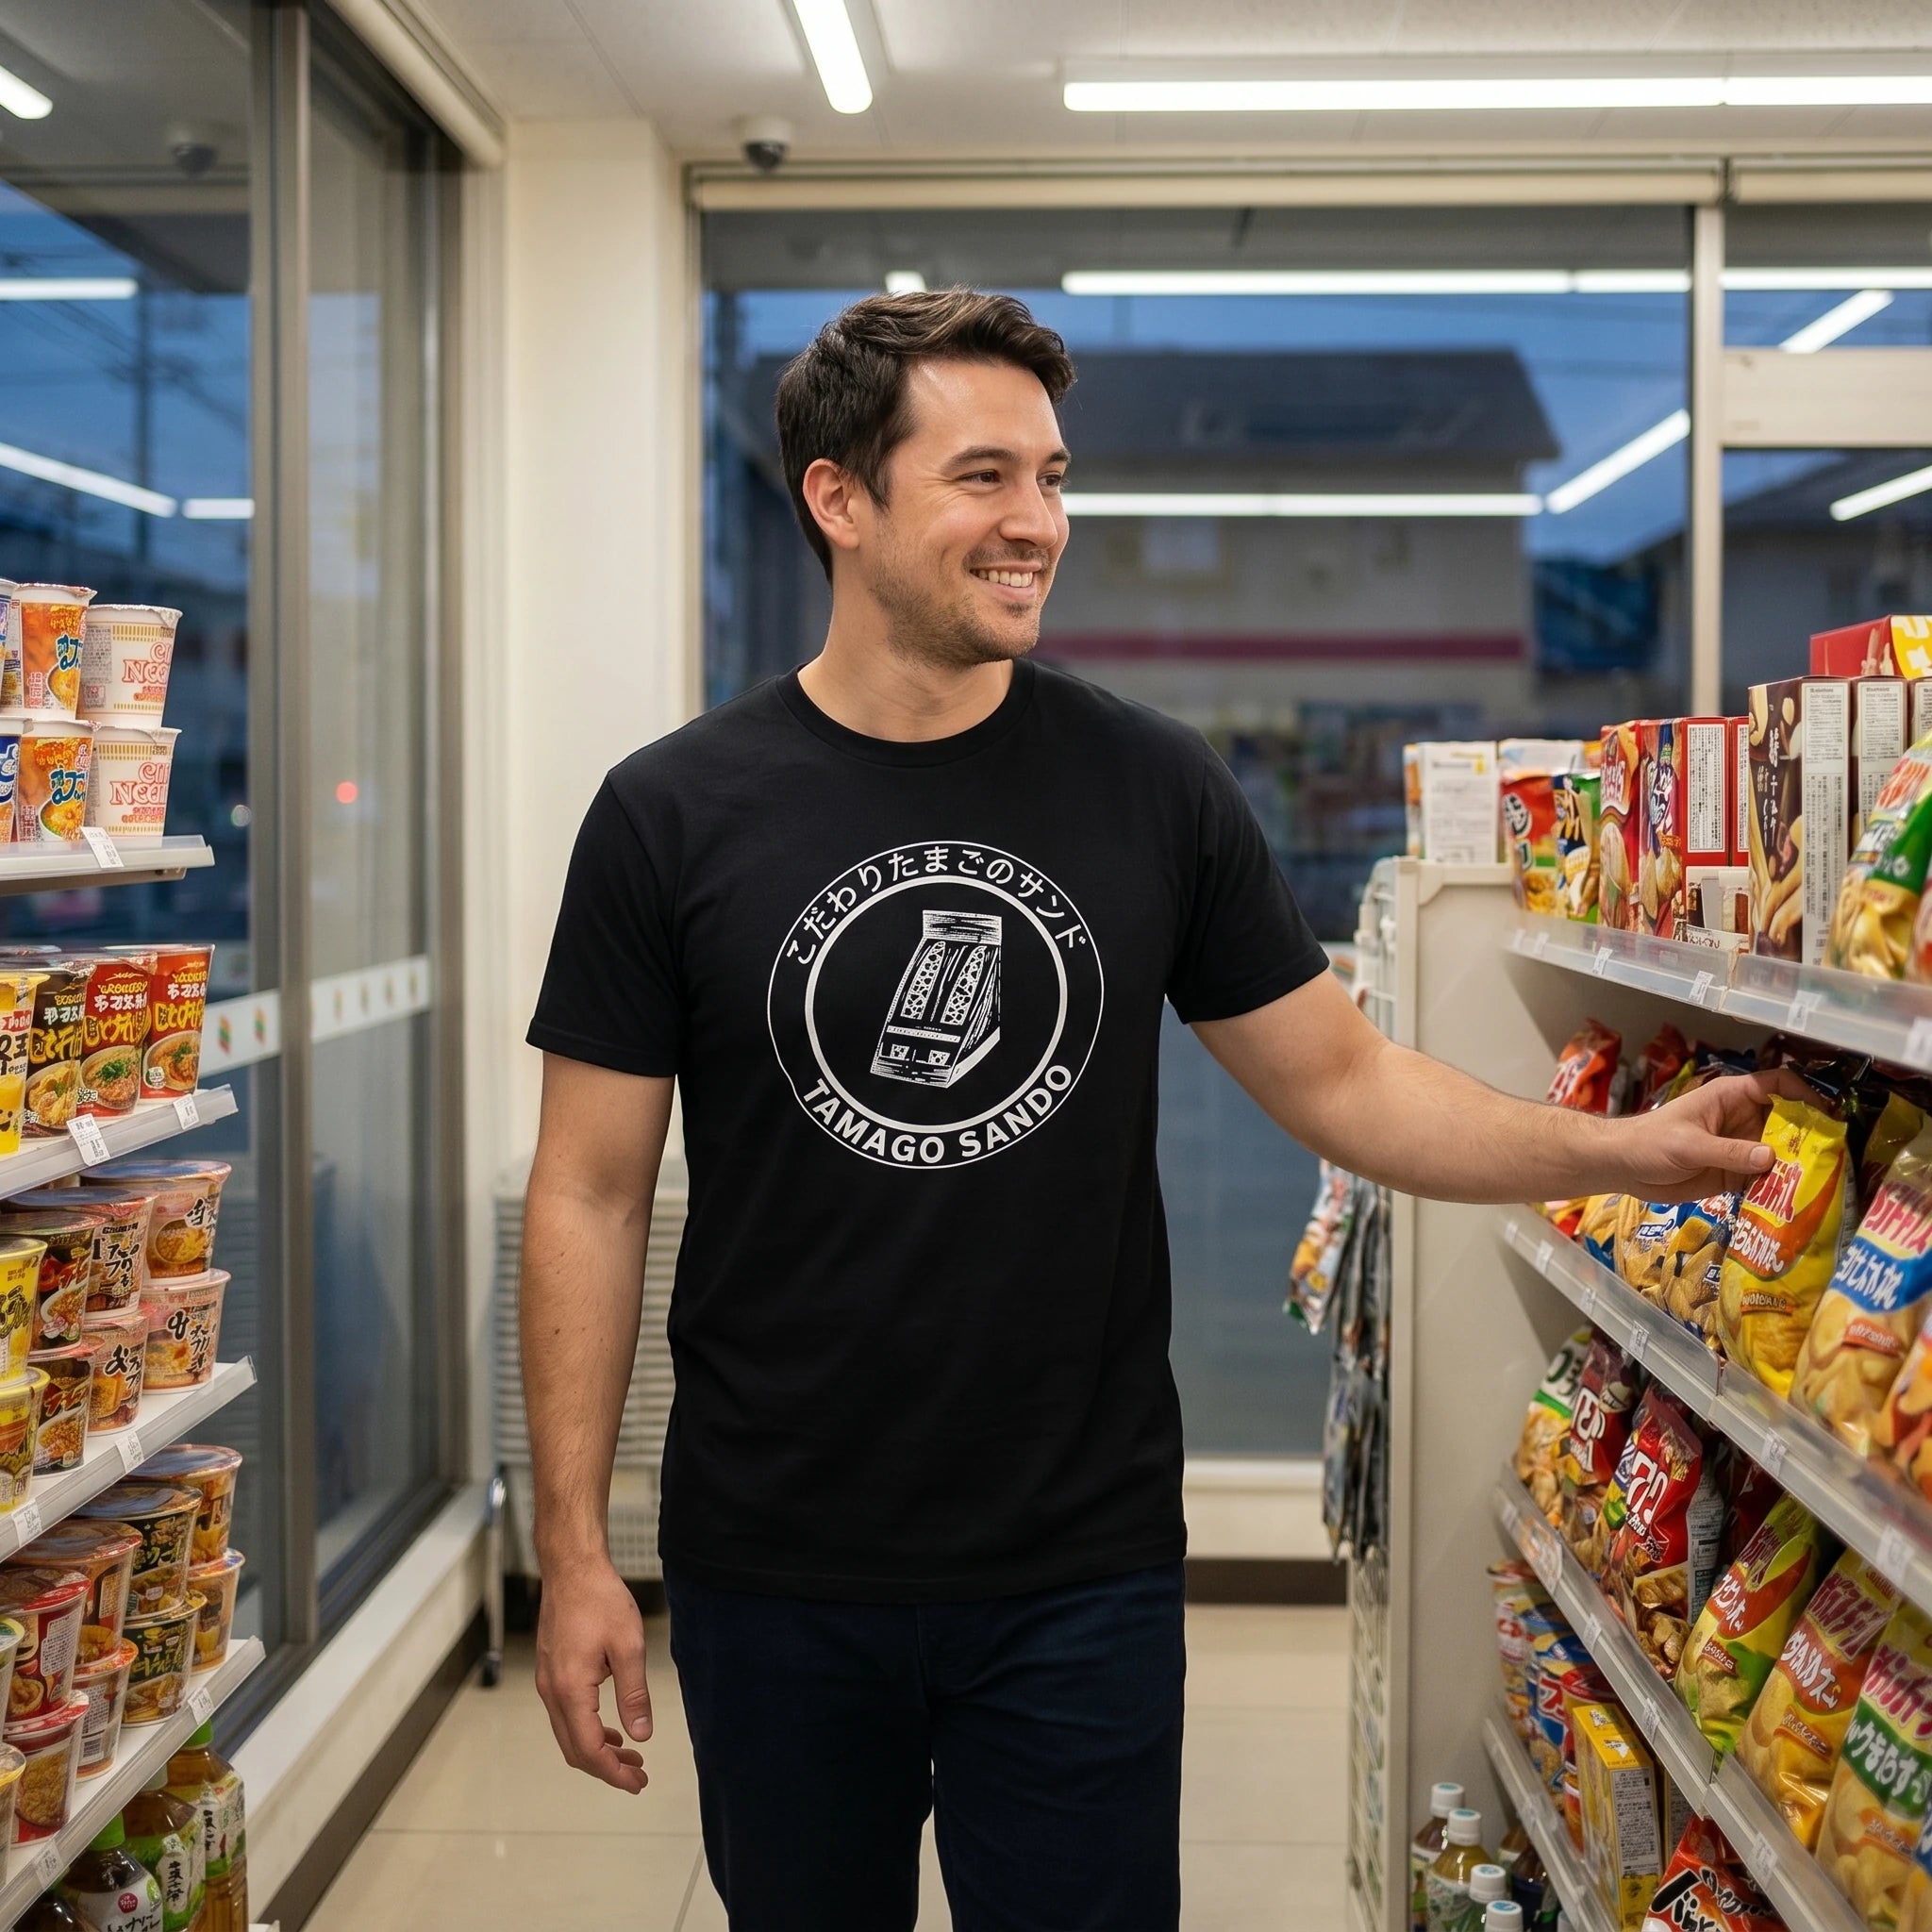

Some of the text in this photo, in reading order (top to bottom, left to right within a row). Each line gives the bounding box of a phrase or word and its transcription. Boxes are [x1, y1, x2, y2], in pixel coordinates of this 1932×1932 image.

[786, 845, 1086, 965] こだわりたまごのサンド
[803, 1064, 1072, 1164] TAMAGO SANDO
